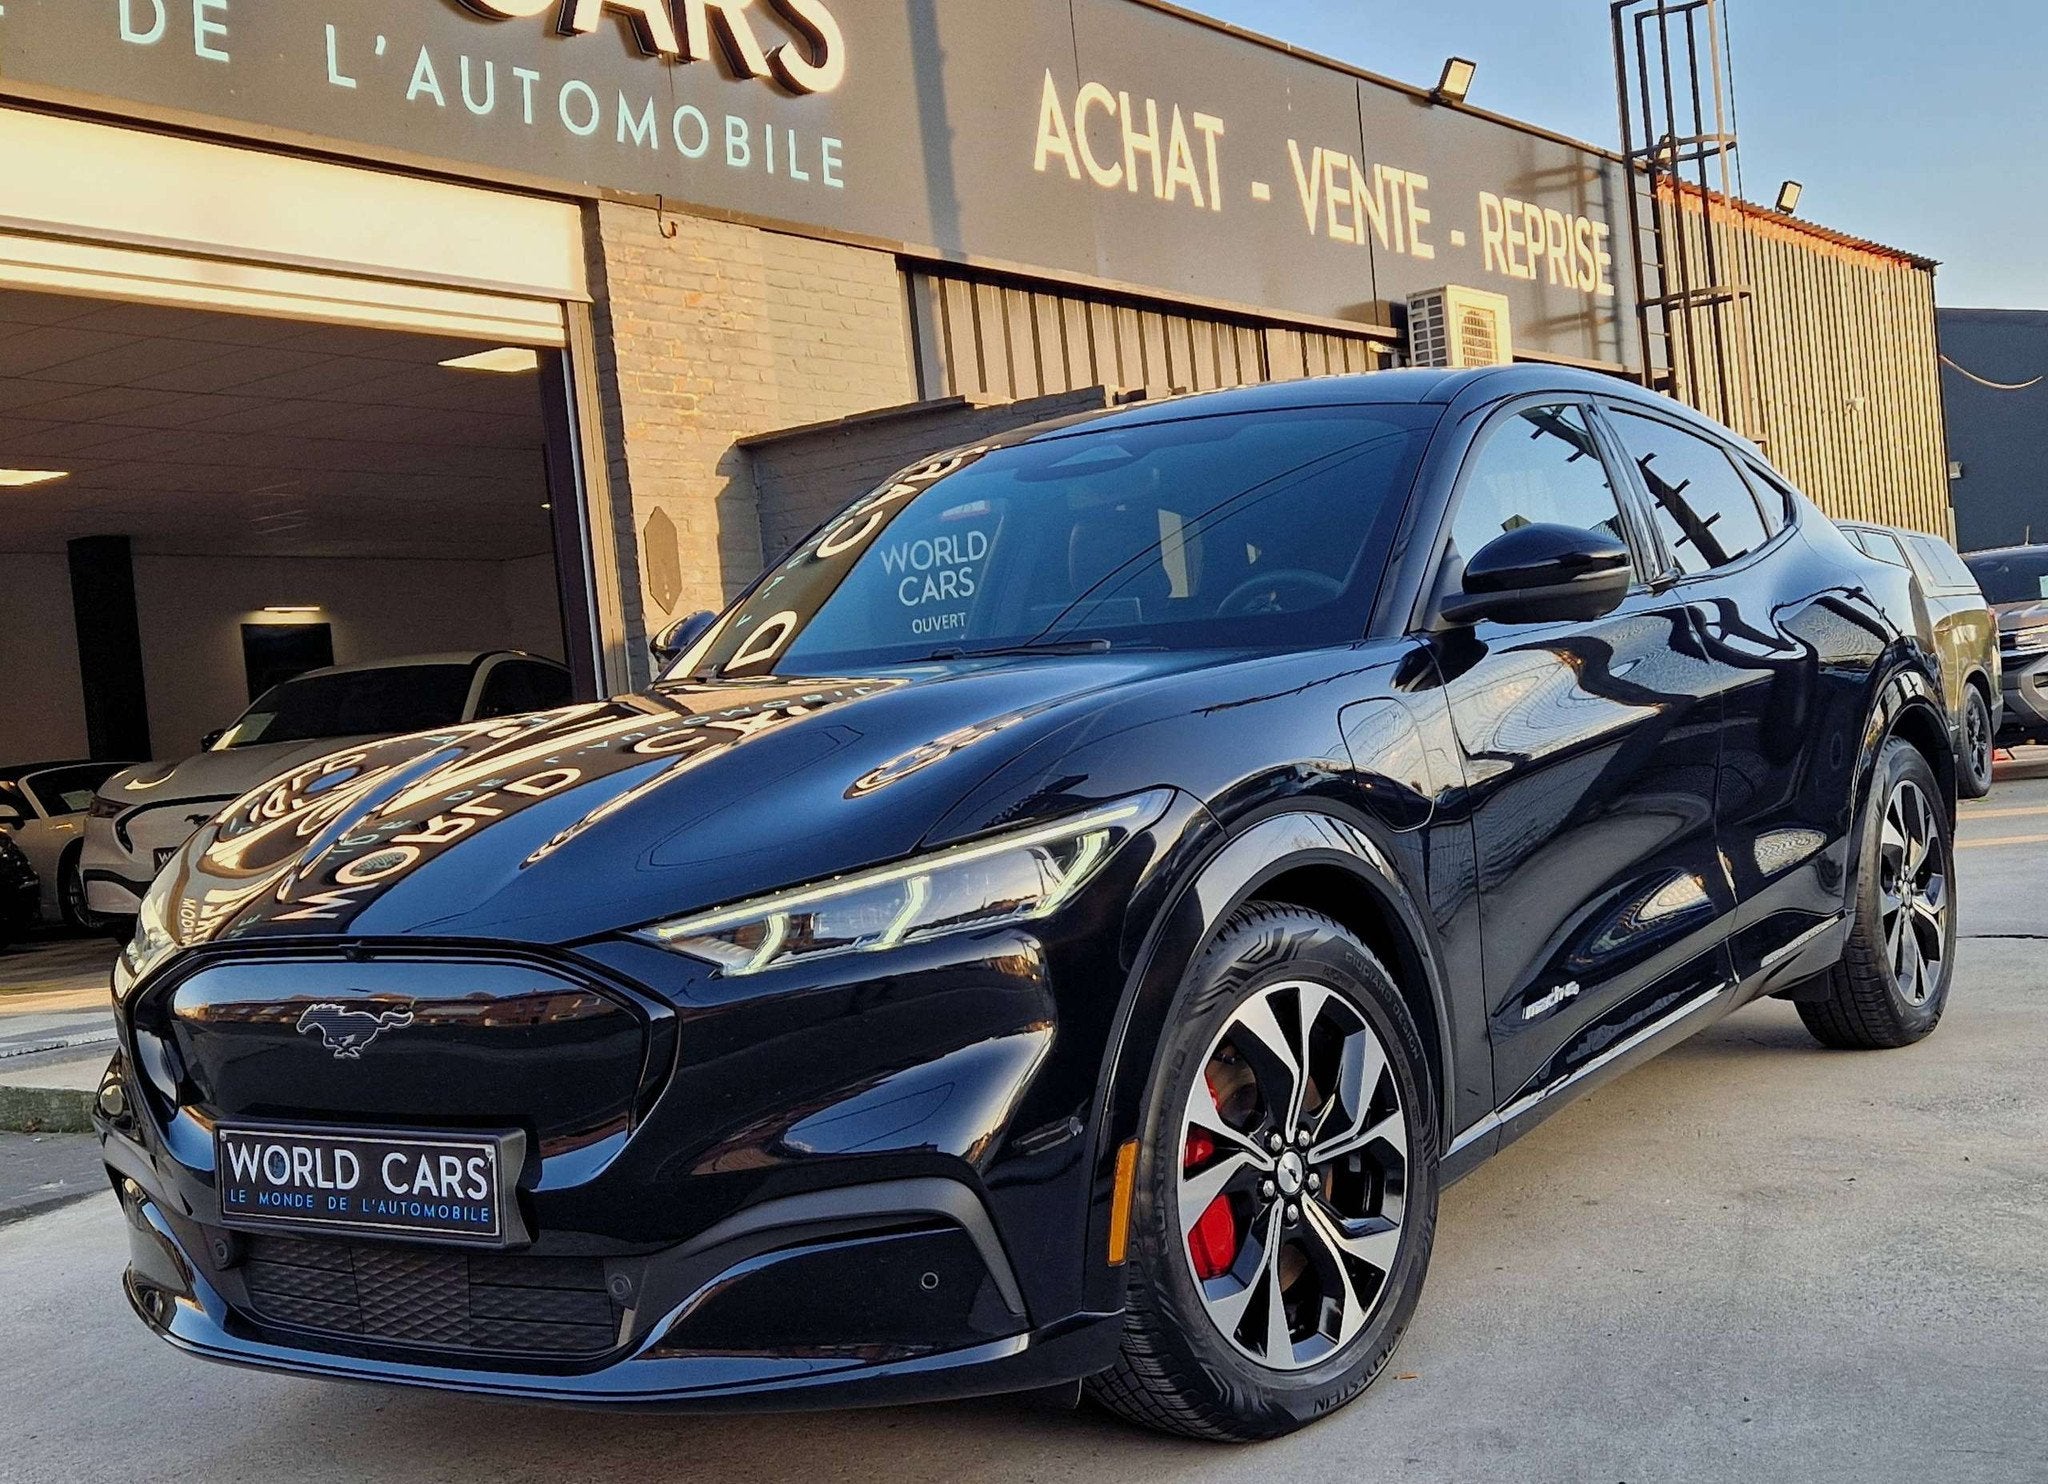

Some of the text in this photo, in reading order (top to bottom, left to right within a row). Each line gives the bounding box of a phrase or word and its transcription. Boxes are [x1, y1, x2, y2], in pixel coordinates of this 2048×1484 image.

[119, 0, 845, 189] DE L'AUTOMOBILE
[1033, 68, 1224, 211] ACHAT
[1287, 138, 1435, 260] VENTE
[1478, 191, 1615, 297] REPRISE
[880, 530, 988, 575] WORLD
[898, 566, 975, 607] CARS
[911, 612, 967, 634] OUVERT
[227, 1141, 488, 1200] WORLD CARS
[230, 1188, 490, 1223] LE MONDE DE L'AUTOMOBILE
